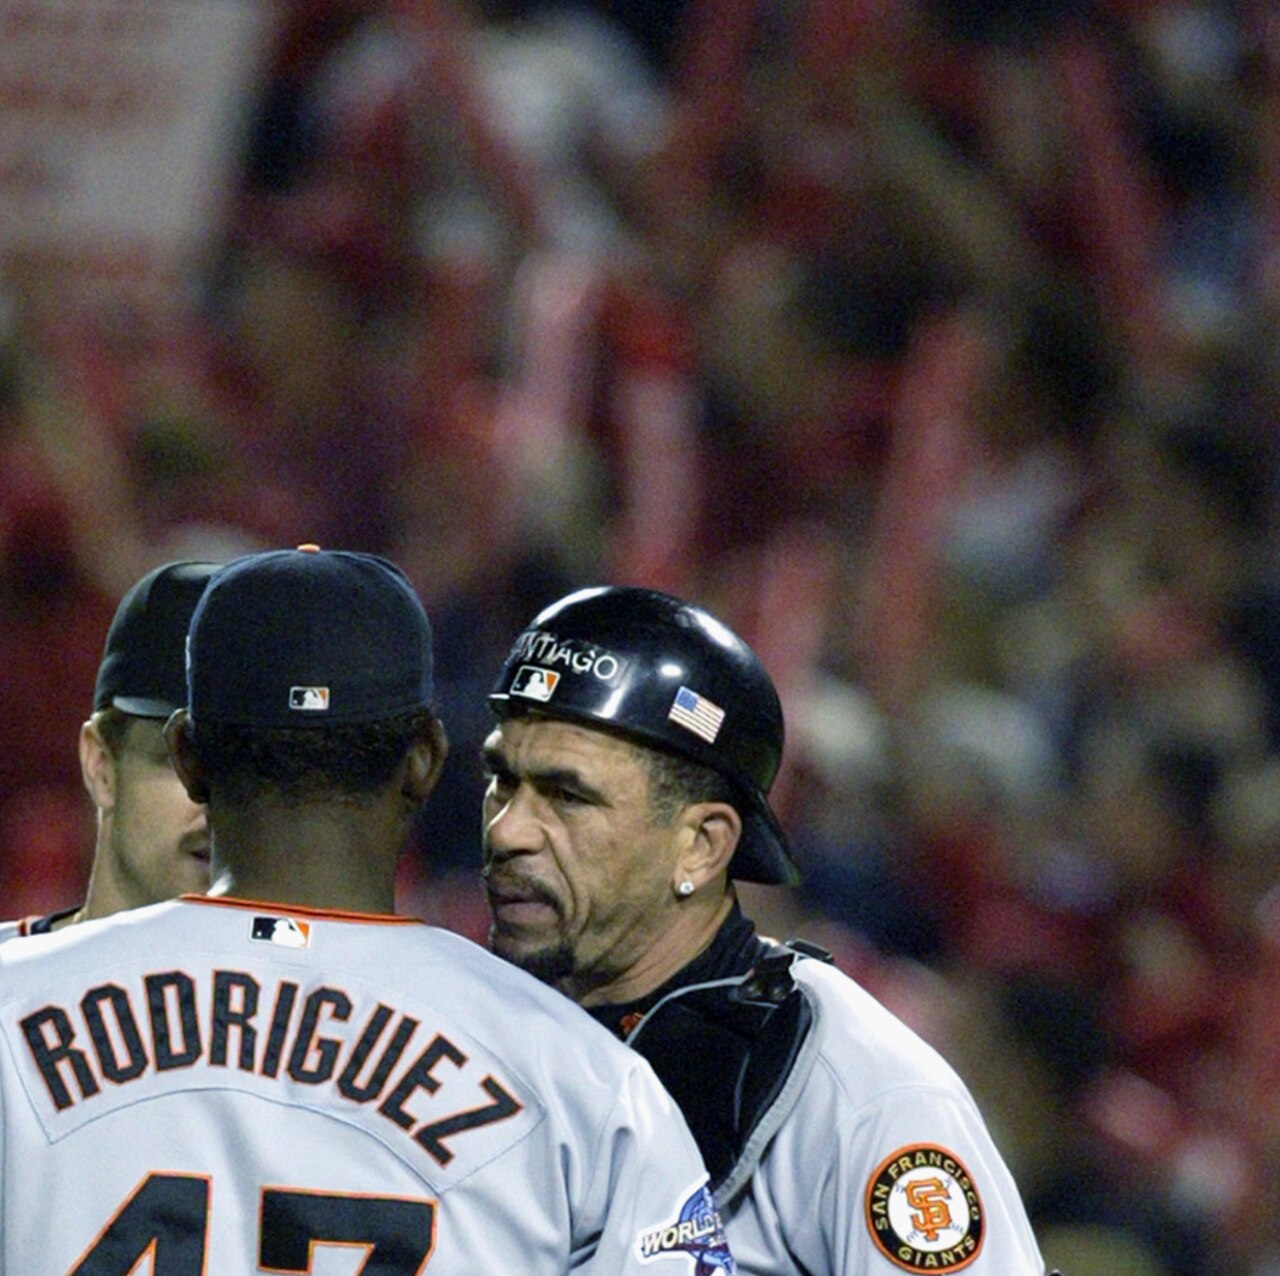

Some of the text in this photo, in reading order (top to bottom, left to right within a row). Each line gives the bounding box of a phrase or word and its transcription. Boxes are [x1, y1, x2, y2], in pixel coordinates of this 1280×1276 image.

[19, 969, 524, 1169] RODRIGUEZ
[872, 1151, 981, 1230] SAN FRANCISCO
[641, 1214, 715, 1257] WORLD
[898, 1235, 976, 1267] GIANTS
